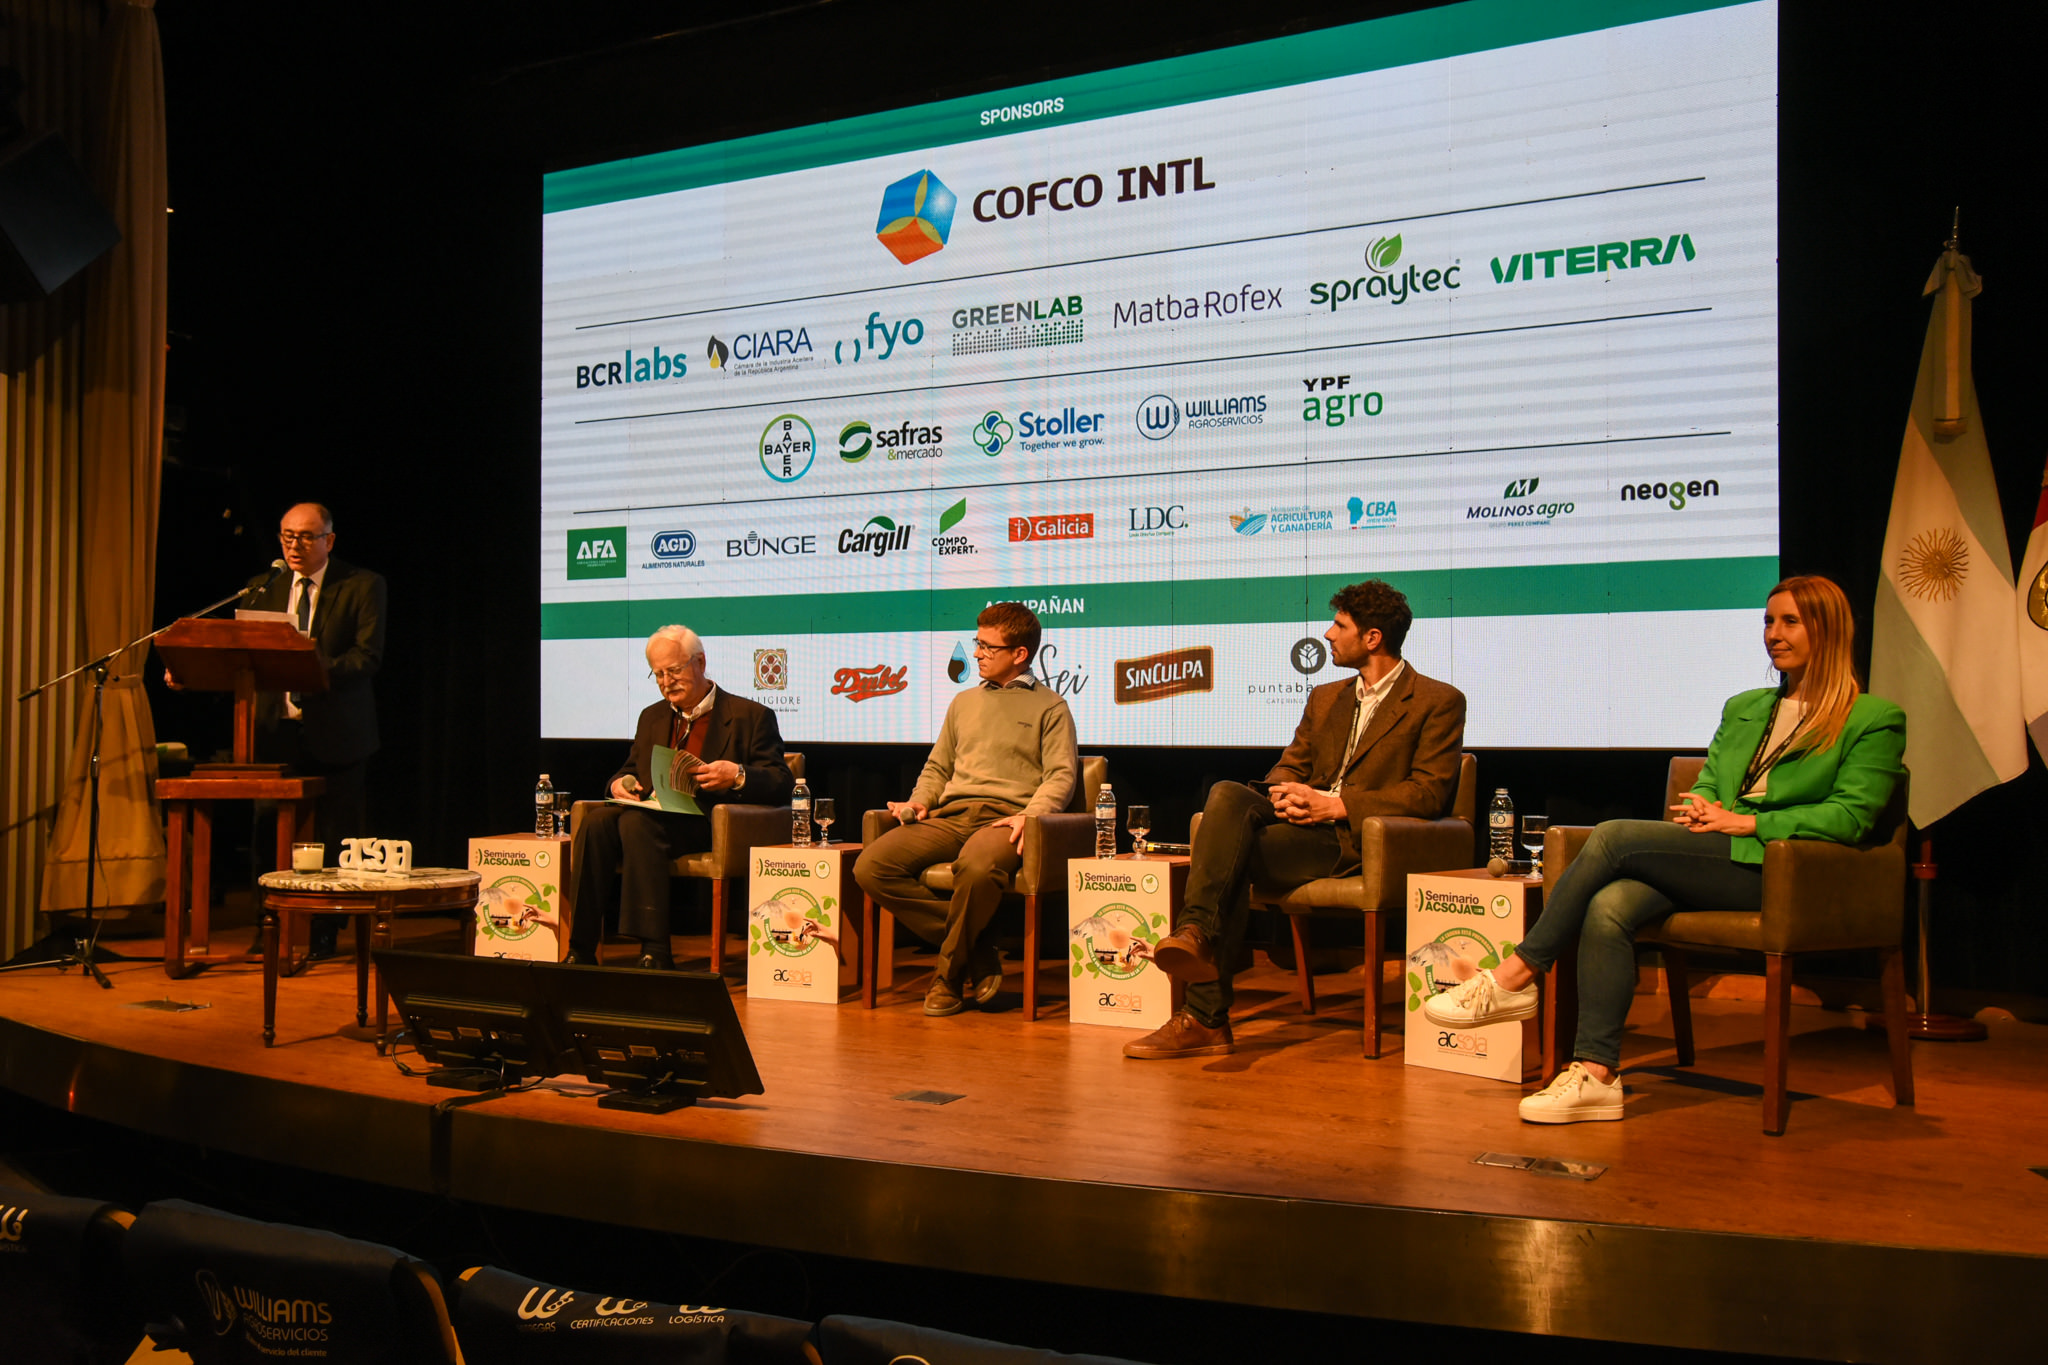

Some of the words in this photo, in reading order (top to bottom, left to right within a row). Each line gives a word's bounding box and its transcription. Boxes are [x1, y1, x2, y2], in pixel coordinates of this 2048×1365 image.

[980, 97, 1064, 126] SPONSORS
[973, 174, 1103, 222] COFCO
[1117, 156, 1216, 202] INTL
[1490, 233, 1696, 284] VITERRA
[1310, 264, 1460, 312] spraytec
[952, 296, 1083, 329] GREENLAB
[733, 327, 813, 360] CIARA
[865, 311, 924, 360] fyo
[1302, 375, 1351, 392] YPF
[1185, 395, 1267, 418] WILLIAMS
[1302, 391, 1383, 427] agro
[1019, 407, 1105, 438] Stoller
[1188, 414, 1264, 430] AGROSERVICIOS
[876, 421, 943, 448] safras
[764, 441, 811, 455] BAYER
[1020, 440, 1060, 453] Together
[1063, 440, 1077, 448] we
[1621, 479, 1719, 511] neogen
[1271, 510, 1333, 523] AGRICULTURA
[1366, 500, 1397, 517] CBA
[1466, 504, 1535, 519] MOLINOS
[1536, 502, 1575, 519] agro
[1035, 518, 1089, 537] Galicia
[1271, 523, 1277, 533] Y
[1279, 521, 1333, 534] GANADERÍA
[576, 539, 617, 559] AFA
[657, 537, 691, 553] AGD
[727, 535, 816, 558] BUNGE
[838, 525, 912, 557] Cargill
[932, 536, 967, 547] COMPO
[641, 561, 672, 569] ALIMENTOS
[673, 560, 705, 568] NATURALES
[986, 595, 1084, 615] APAÑAN
[483, 857, 520, 867] ACSOJA
[484, 849, 526, 859] Seminario
[764, 860, 807, 869] Seminario
[764, 868, 800, 877] ACSOJA
[1084, 872, 1132, 883] Seminario
[1085, 882, 1125, 892] ACSOJA
[1425, 890, 1480, 904] Seminario
[1425, 901, 1472, 915] ACSOJA
[233, 1285, 334, 1325] WILLIAMS
[570, 1316, 655, 1330] CERTIFICACIONES
[668, 1314, 725, 1325] LOGÍSTICA
